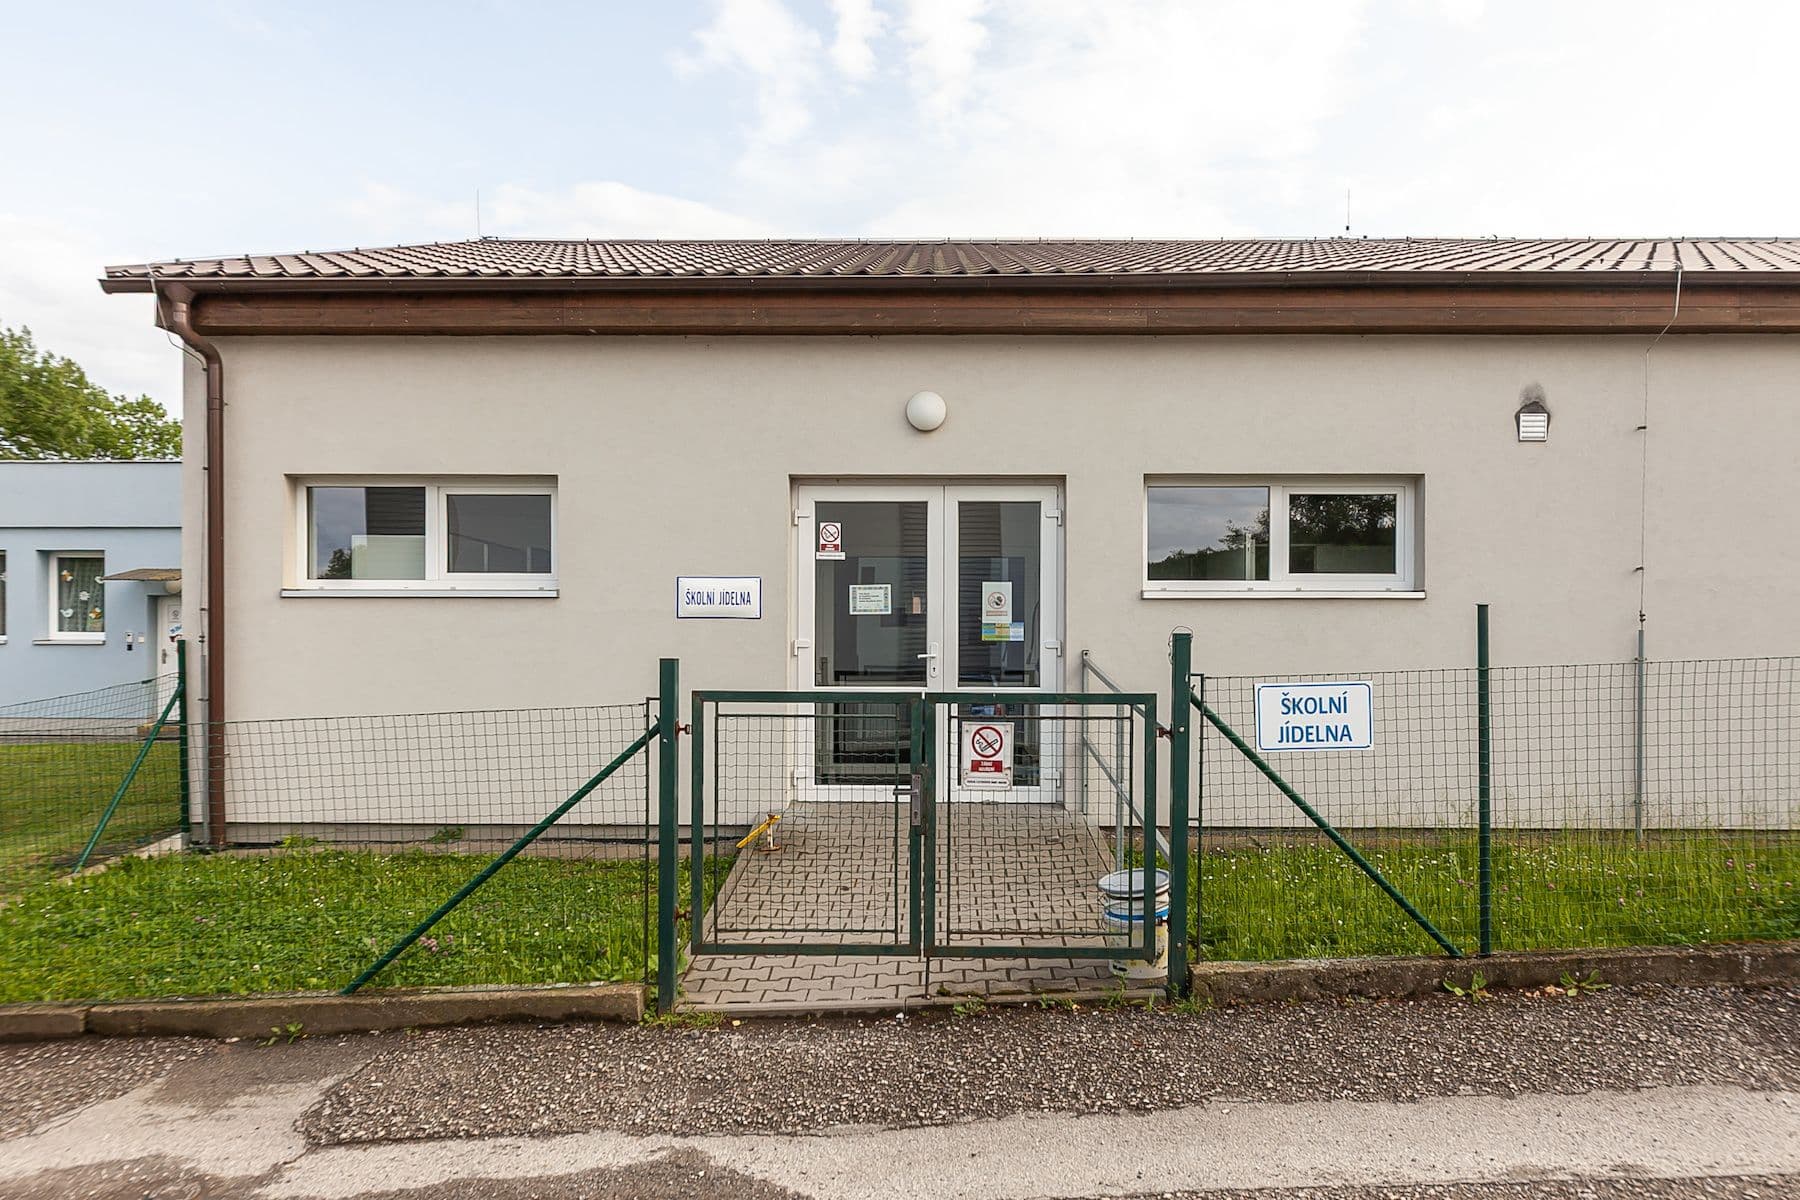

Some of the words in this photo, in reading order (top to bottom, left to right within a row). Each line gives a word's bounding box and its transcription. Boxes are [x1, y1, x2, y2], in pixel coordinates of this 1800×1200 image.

[685, 588, 715, 605] ŠKOLNÍ
[719, 588, 752, 605] JÍDELNA
[1281, 691, 1348, 715] ŠKOLNÍ
[1278, 720, 1353, 743] JÍDELNA
